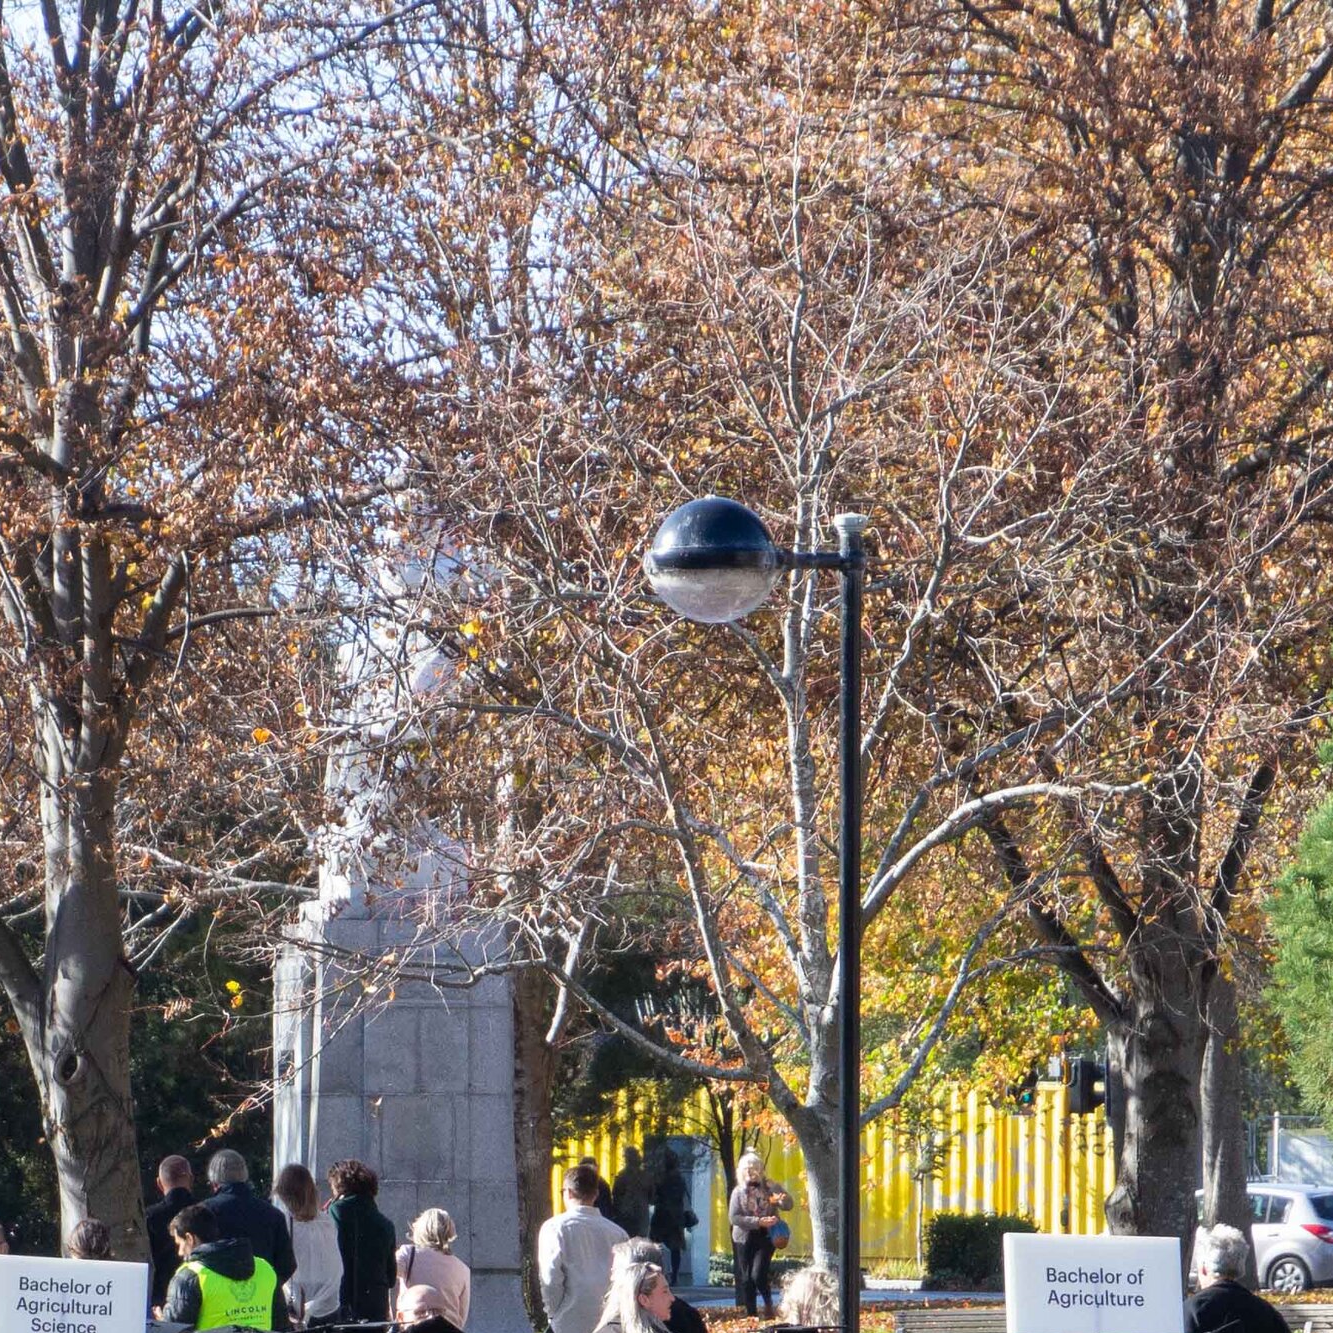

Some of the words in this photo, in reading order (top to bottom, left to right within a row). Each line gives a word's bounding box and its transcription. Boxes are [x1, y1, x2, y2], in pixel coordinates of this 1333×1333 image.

[19, 1276, 92, 1294] Bachelor
[95, 1280, 113, 1296] of
[1046, 1267, 1123, 1284] Bachelor
[1127, 1269, 1145, 1285] of
[16, 1296, 113, 1316] Agricultural
[1047, 1289, 1145, 1309] Agriculture
